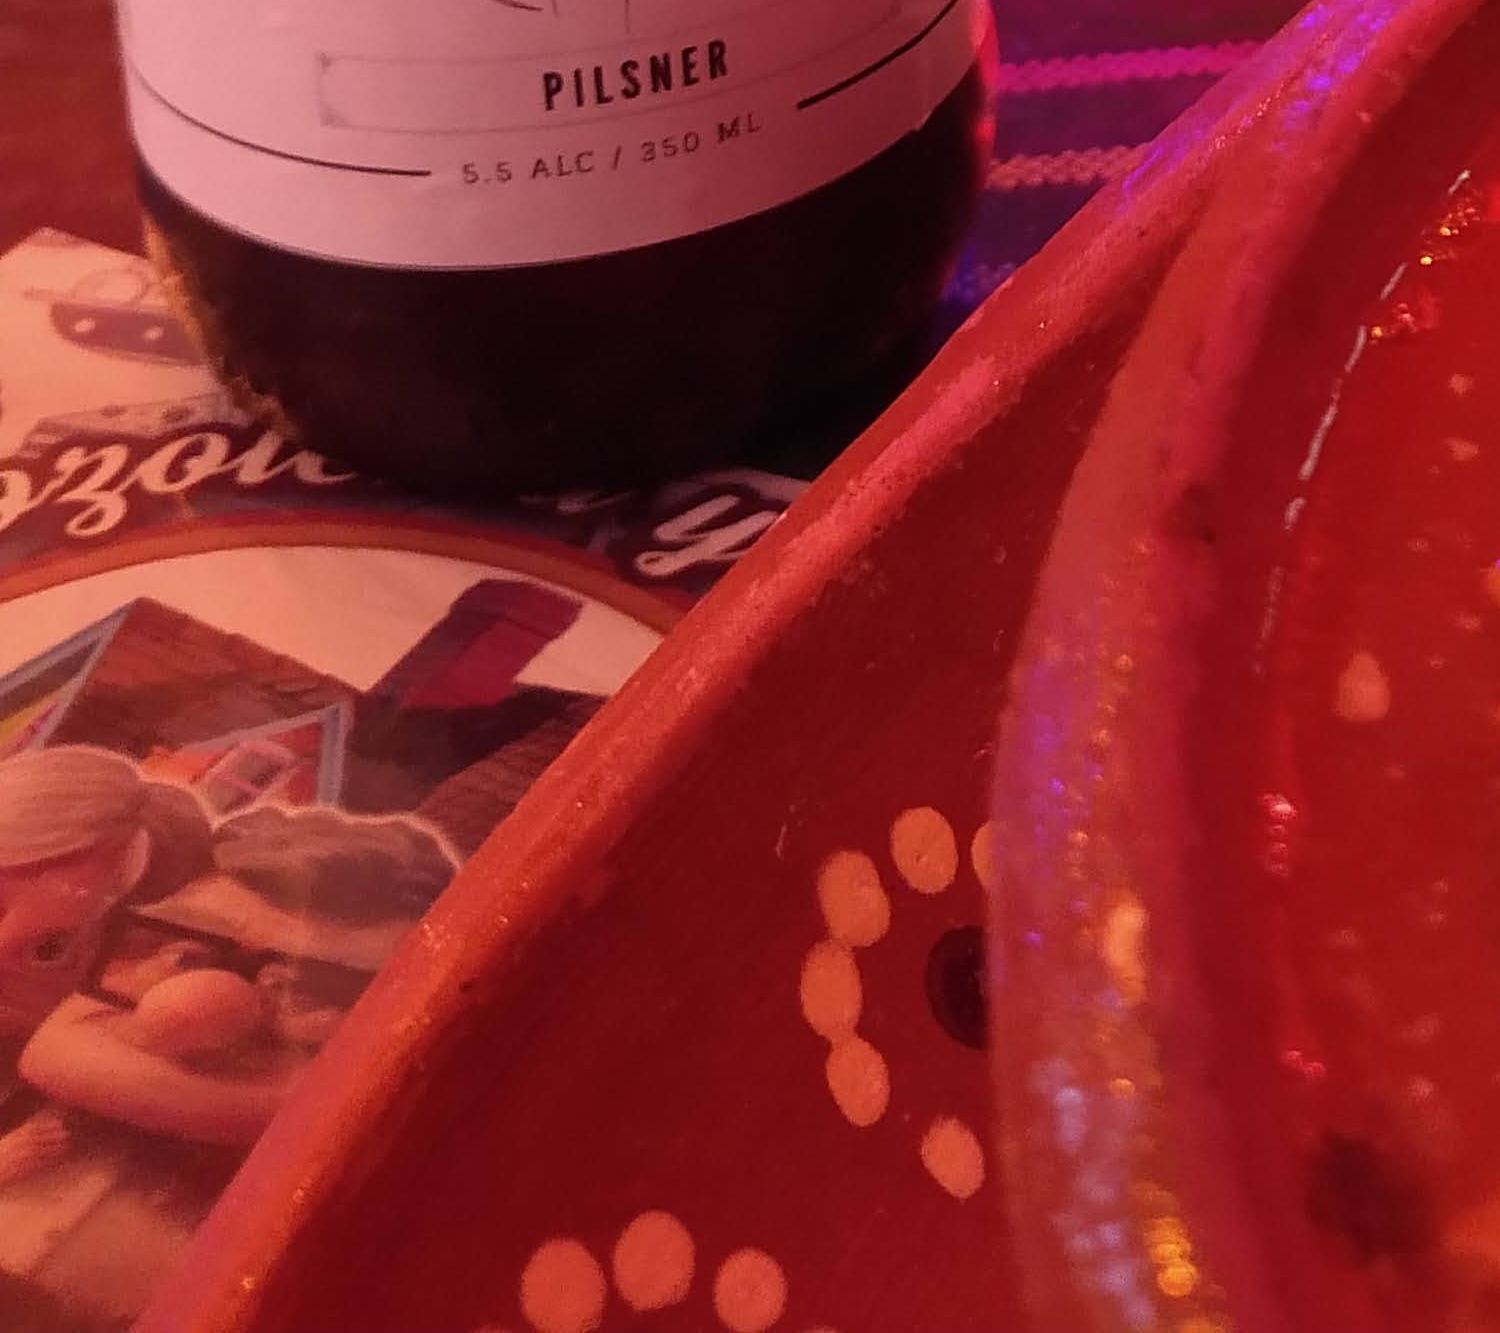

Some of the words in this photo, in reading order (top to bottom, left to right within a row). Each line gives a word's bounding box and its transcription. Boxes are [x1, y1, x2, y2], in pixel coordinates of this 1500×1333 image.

[542, 39, 728, 111] PILSNER
[462, 161, 513, 184] 5.5
[530, 150, 596, 180] ALC
[610, 145, 623, 171] /
[640, 131, 700, 163] 350
[716, 112, 763, 145] ML
